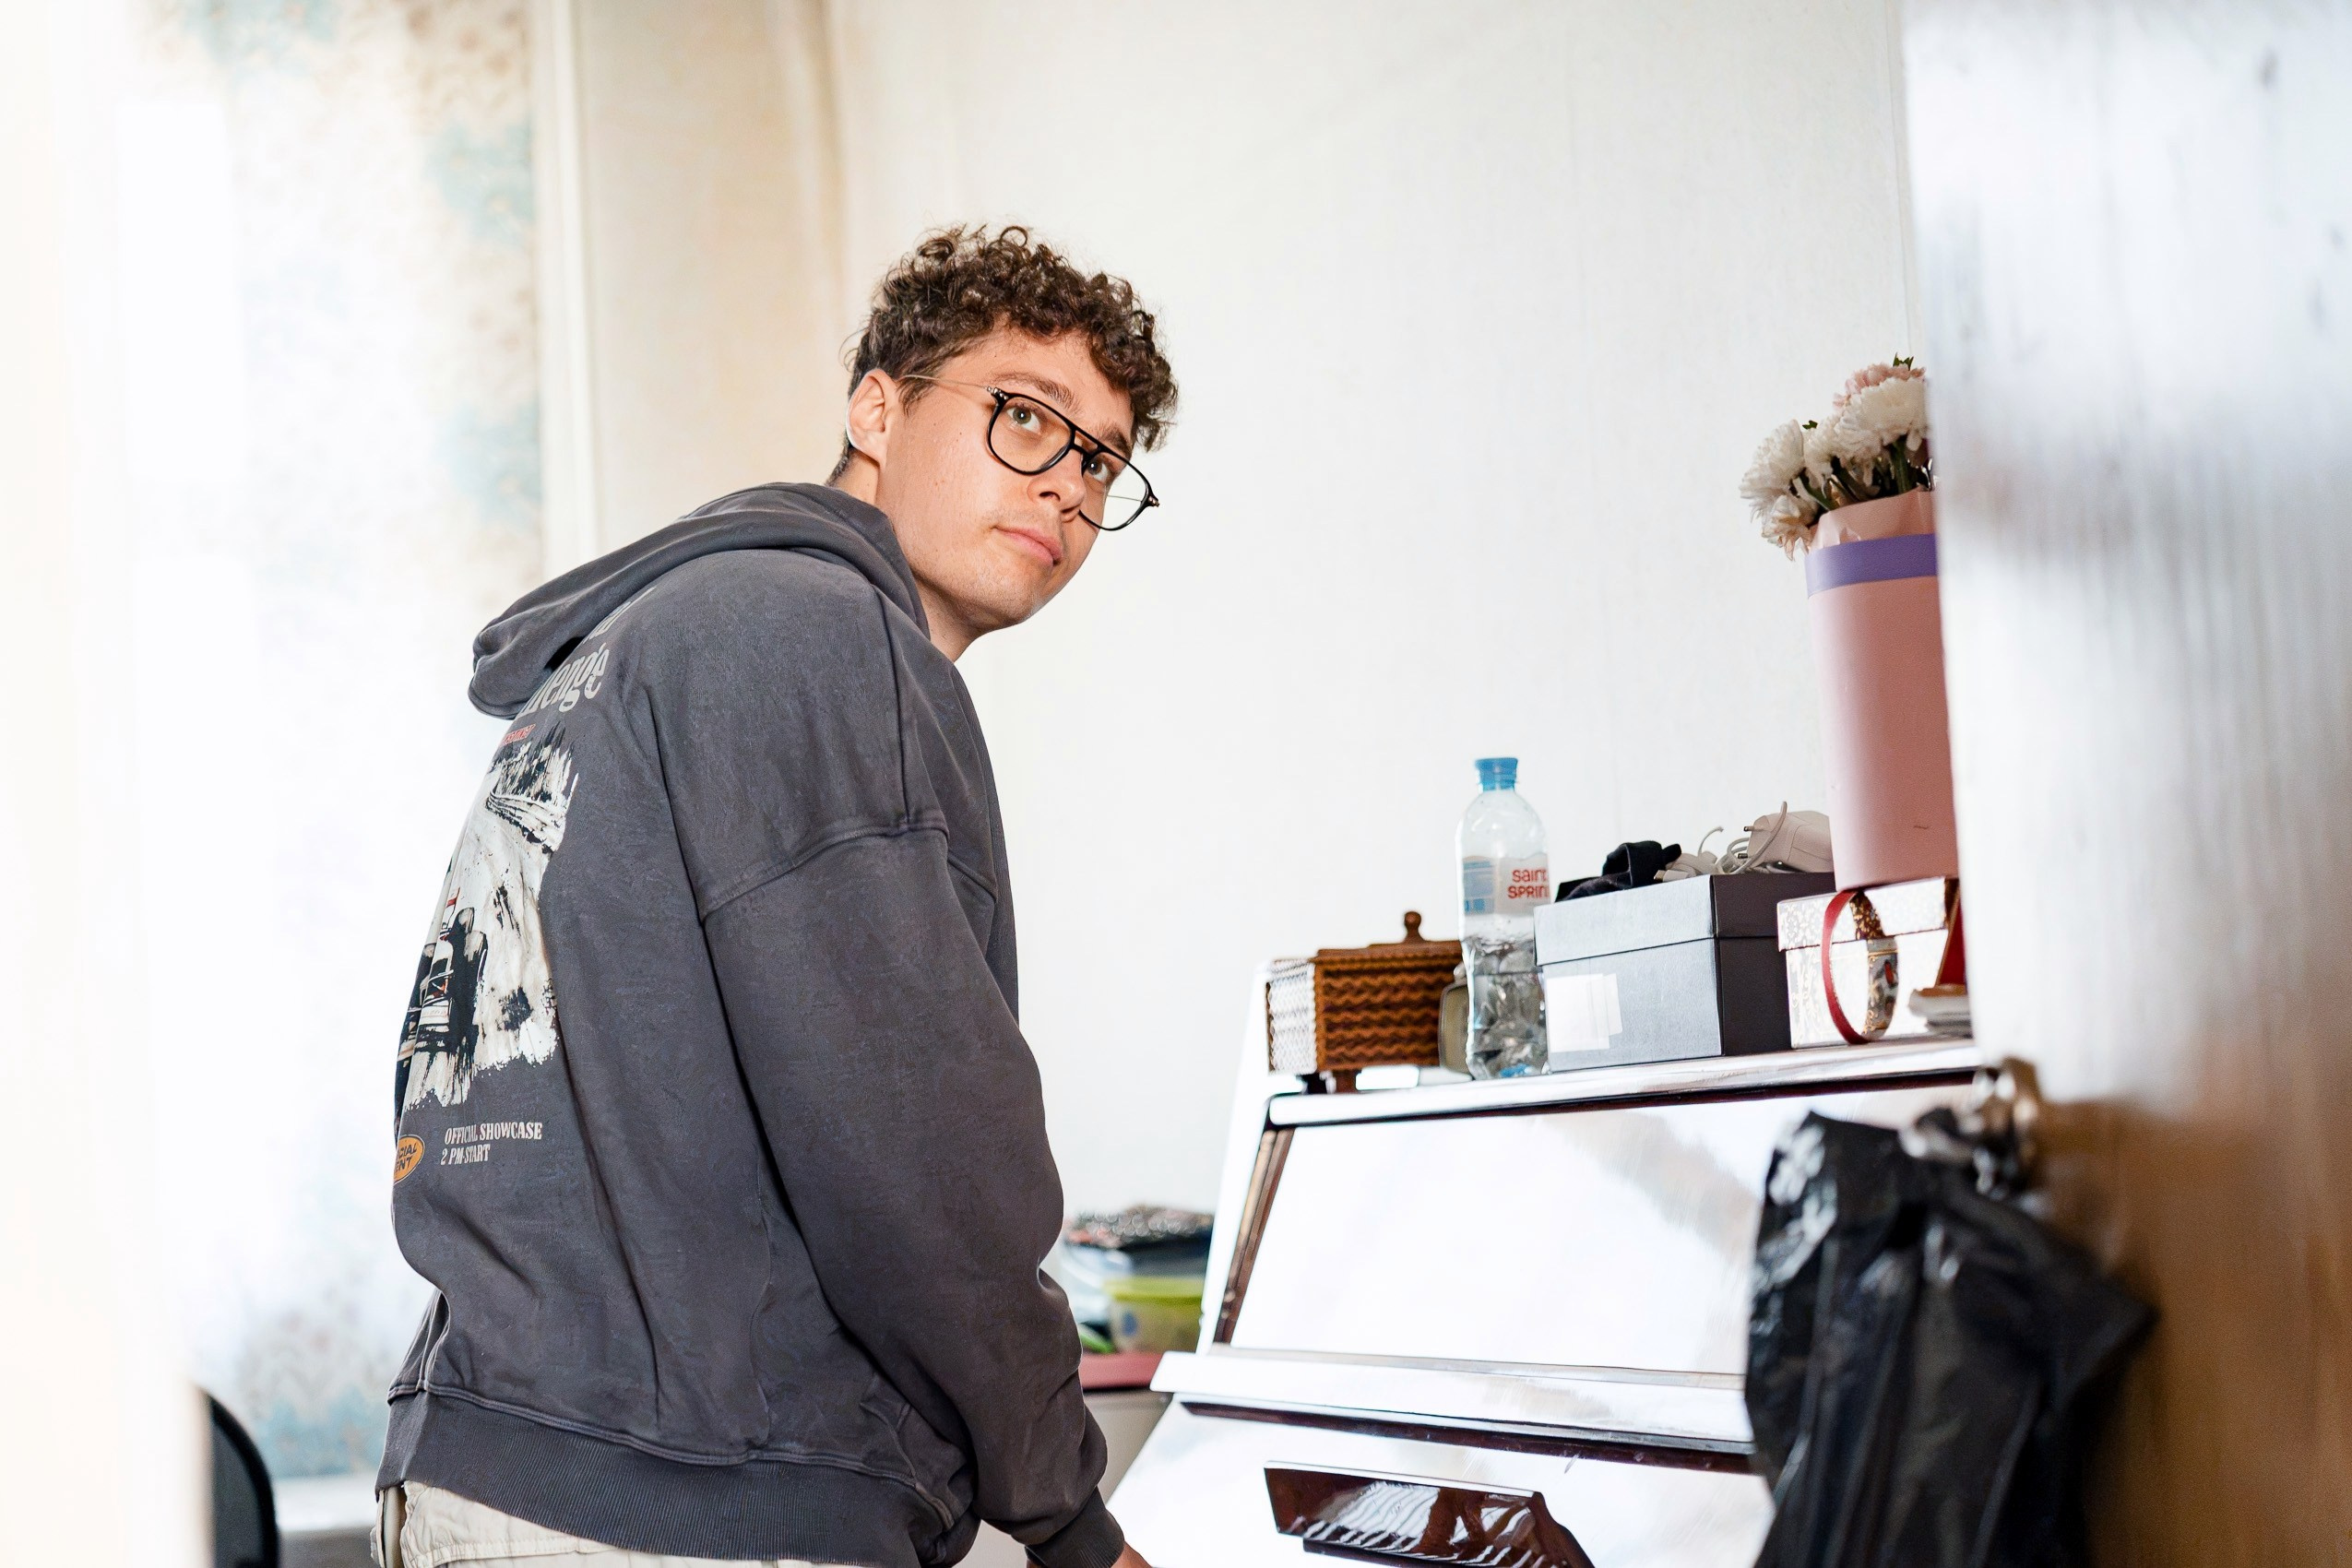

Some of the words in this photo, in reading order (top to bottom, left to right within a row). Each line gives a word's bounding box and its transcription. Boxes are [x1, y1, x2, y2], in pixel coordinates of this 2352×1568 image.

[445, 1123, 478, 1146] OFFICIAL
[479, 1122, 542, 1141] SHOWCASE
[440, 1147, 448, 1165] 2
